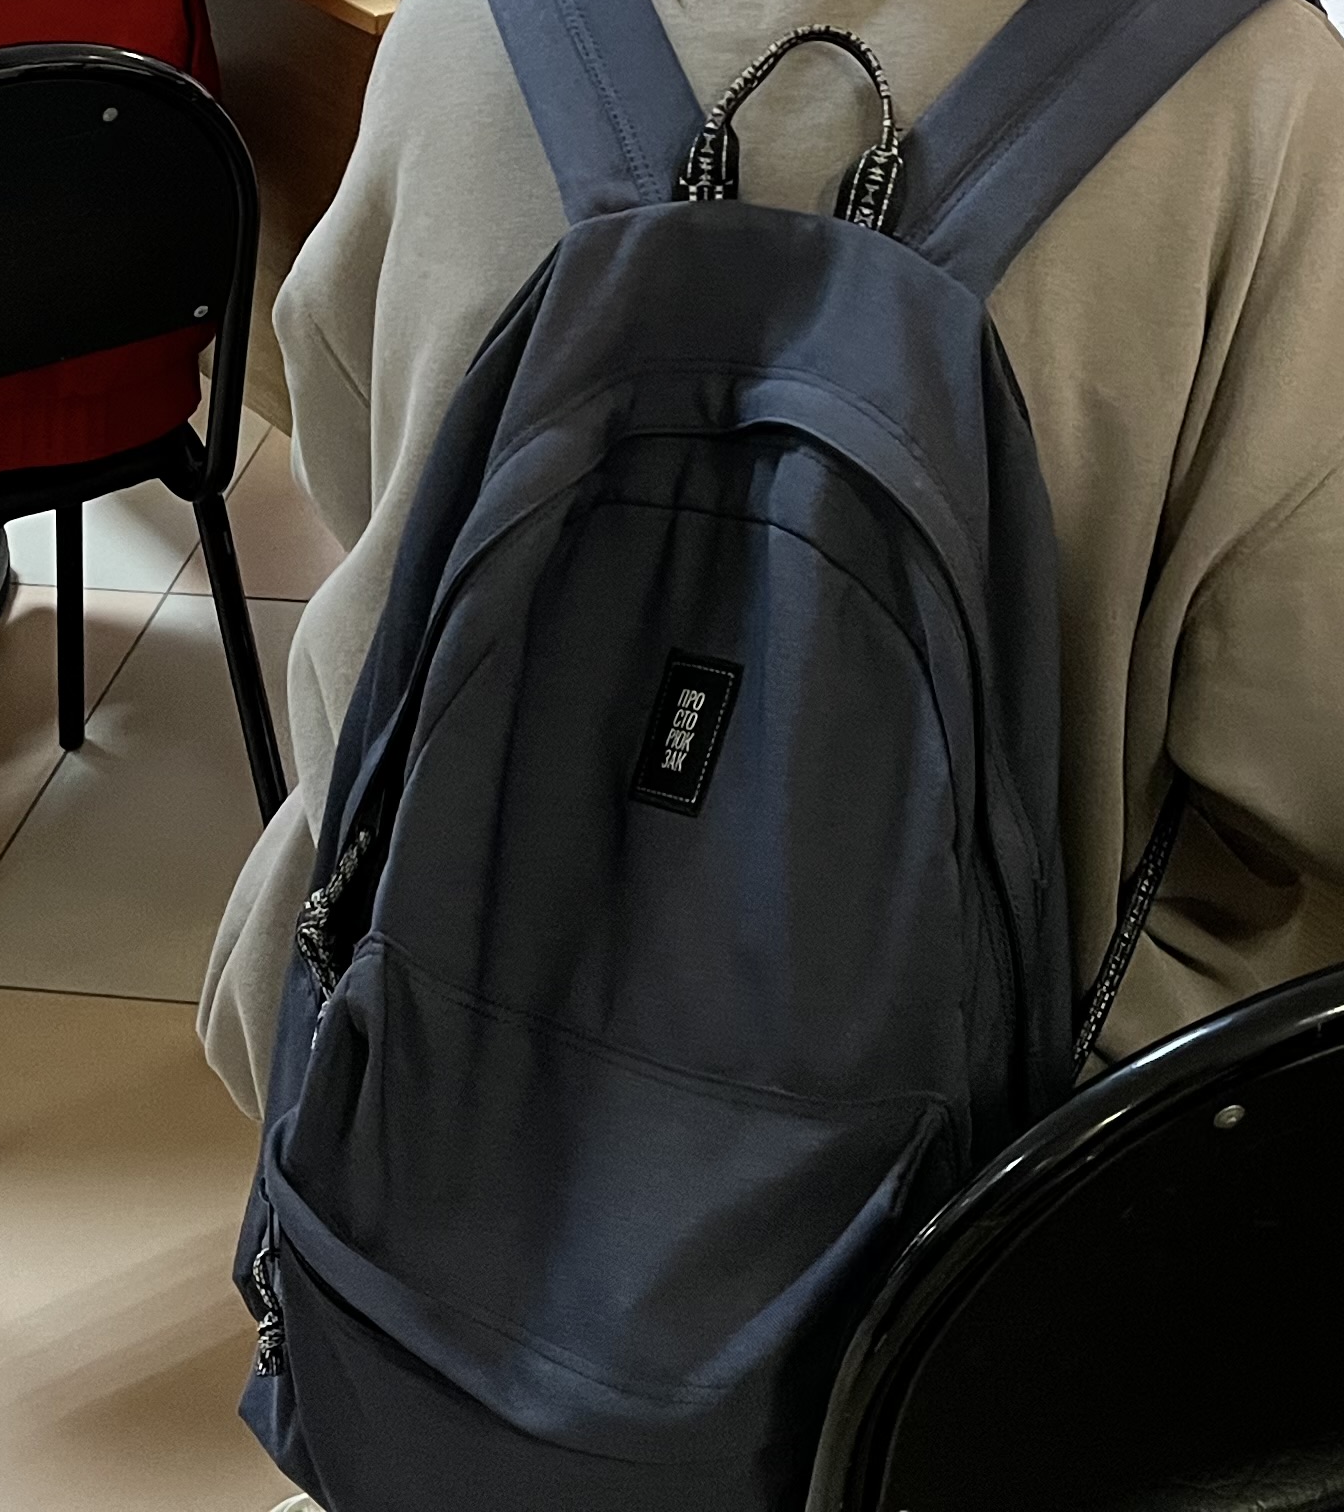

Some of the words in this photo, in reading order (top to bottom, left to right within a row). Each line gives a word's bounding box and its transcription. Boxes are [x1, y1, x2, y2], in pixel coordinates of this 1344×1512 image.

[677, 688, 706, 711] ПРО
[673, 709, 698, 730] СТО
[665, 728, 695, 752] РЮК
[661, 749, 687, 772] ЗАК
